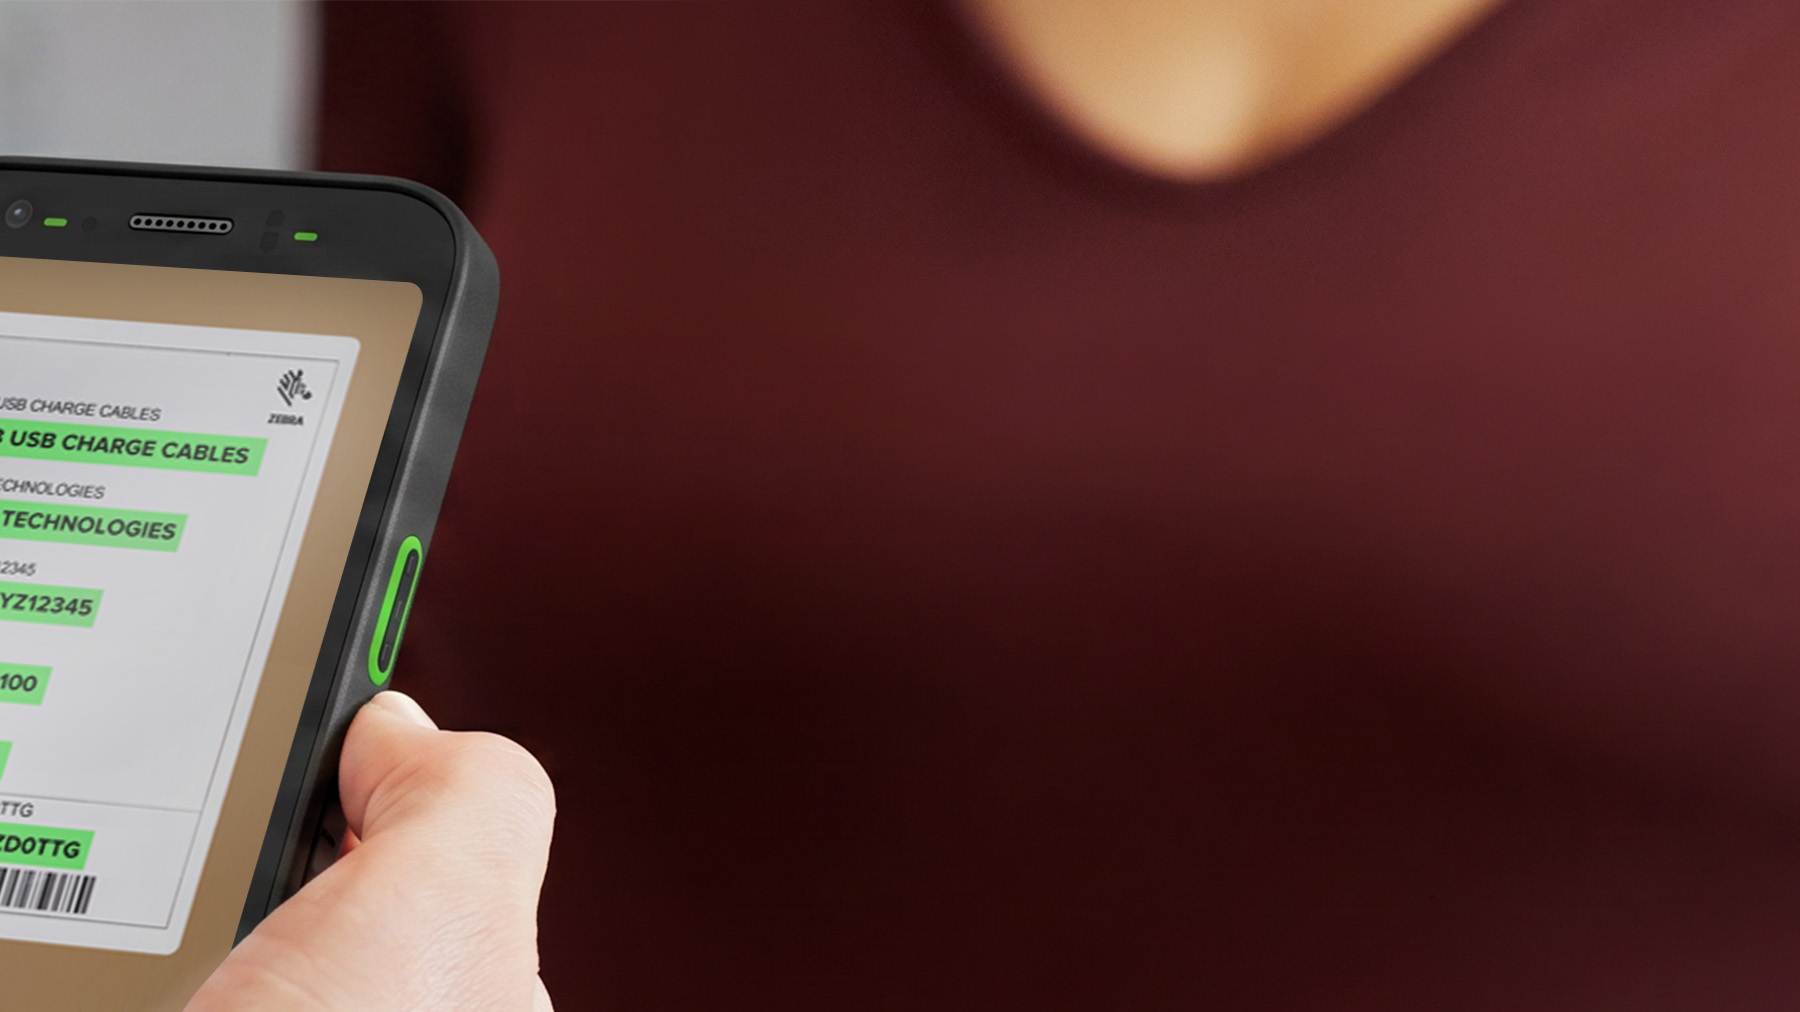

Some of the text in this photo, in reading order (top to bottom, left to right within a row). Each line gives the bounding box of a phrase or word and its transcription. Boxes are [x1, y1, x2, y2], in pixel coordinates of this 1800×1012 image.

[30, 399, 96, 417] CHARGE
[99, 404, 162, 421] CABLES
[267, 413, 304, 425] ZEBRA
[10, 430, 56, 448] USB
[61, 434, 157, 457] CHARGE
[161, 442, 251, 464] CABLES
[1, 509, 177, 540] TECHNOLOGIES
